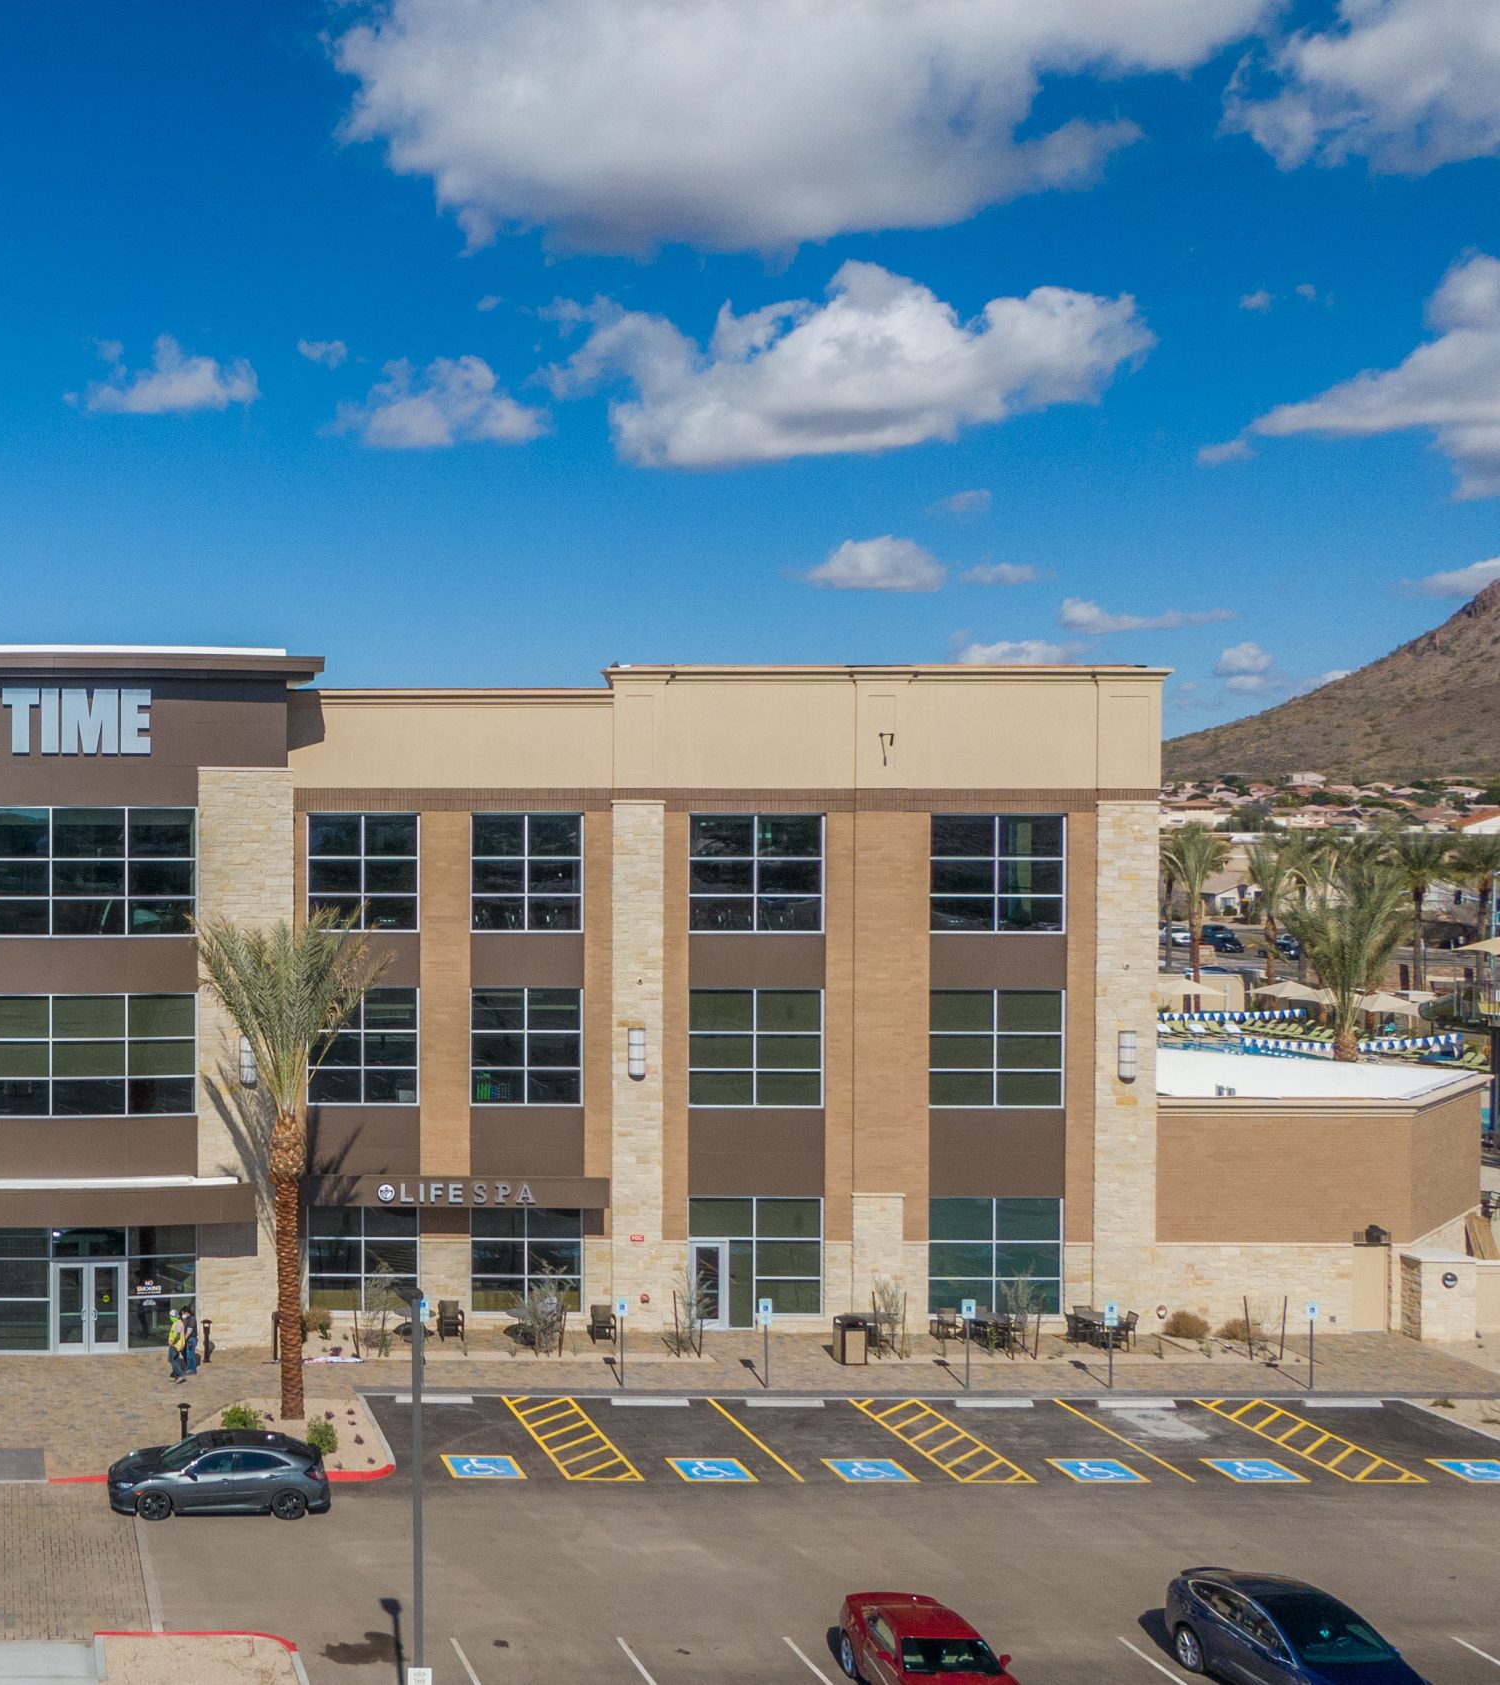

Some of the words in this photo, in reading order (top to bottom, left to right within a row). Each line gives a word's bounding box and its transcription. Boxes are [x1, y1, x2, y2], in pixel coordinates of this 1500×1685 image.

[2, 688, 152, 754] TIME
[400, 1183, 464, 1204] LIFE
[473, 1183, 537, 1205] SPA
